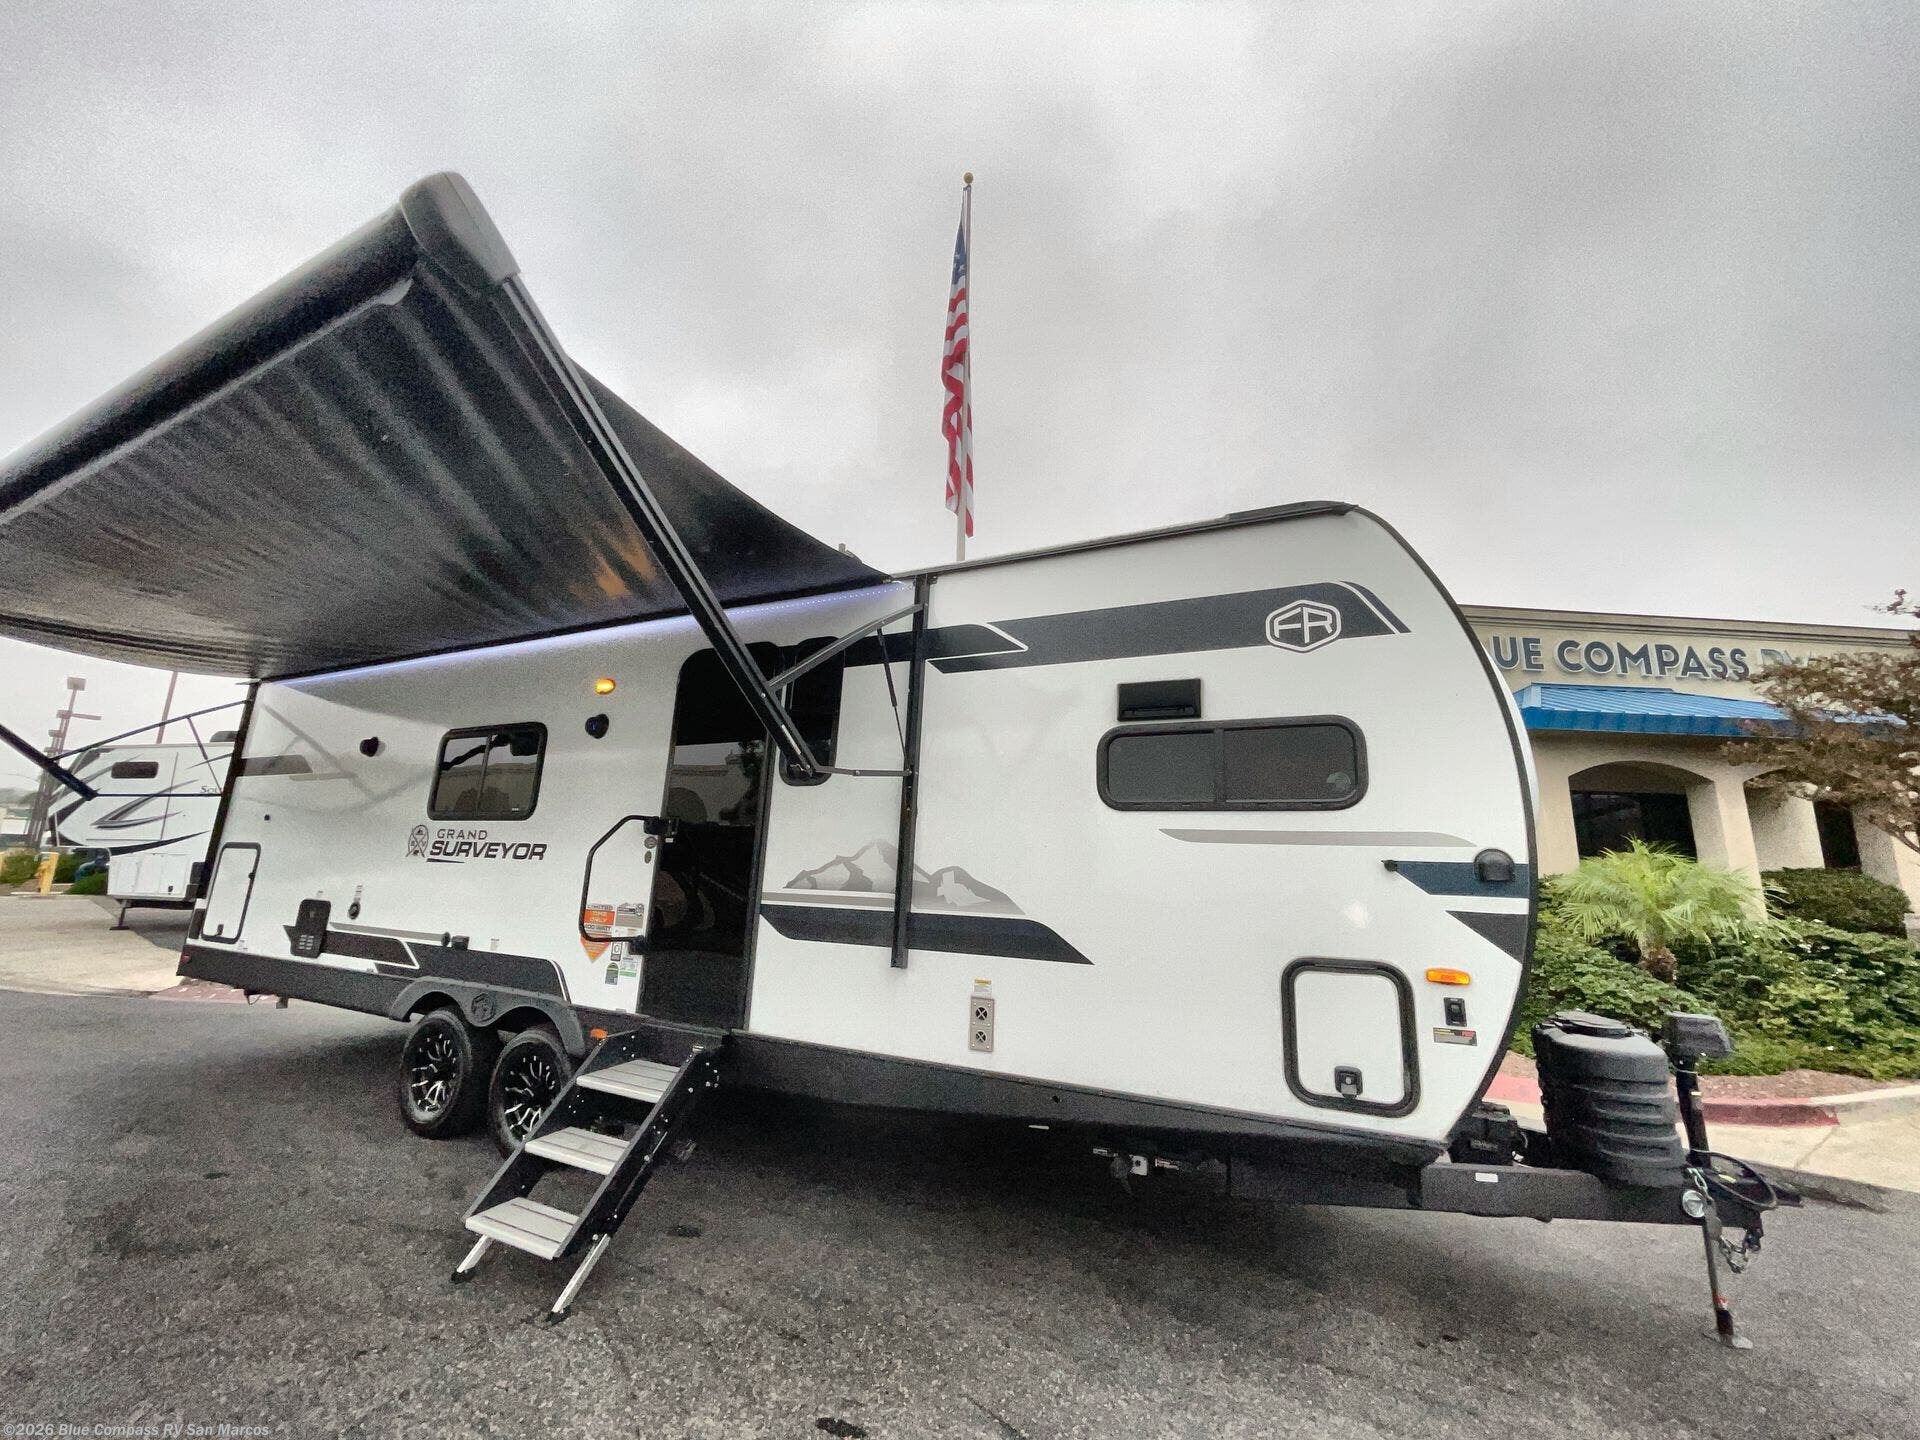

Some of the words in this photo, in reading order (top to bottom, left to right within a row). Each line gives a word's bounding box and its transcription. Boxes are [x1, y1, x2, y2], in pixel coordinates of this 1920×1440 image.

[1273, 606, 1334, 644] FR
[1554, 639, 1750, 680] COMPASS
[436, 828, 489, 840] GRAND
[429, 840, 548, 861] SURVEYOR
